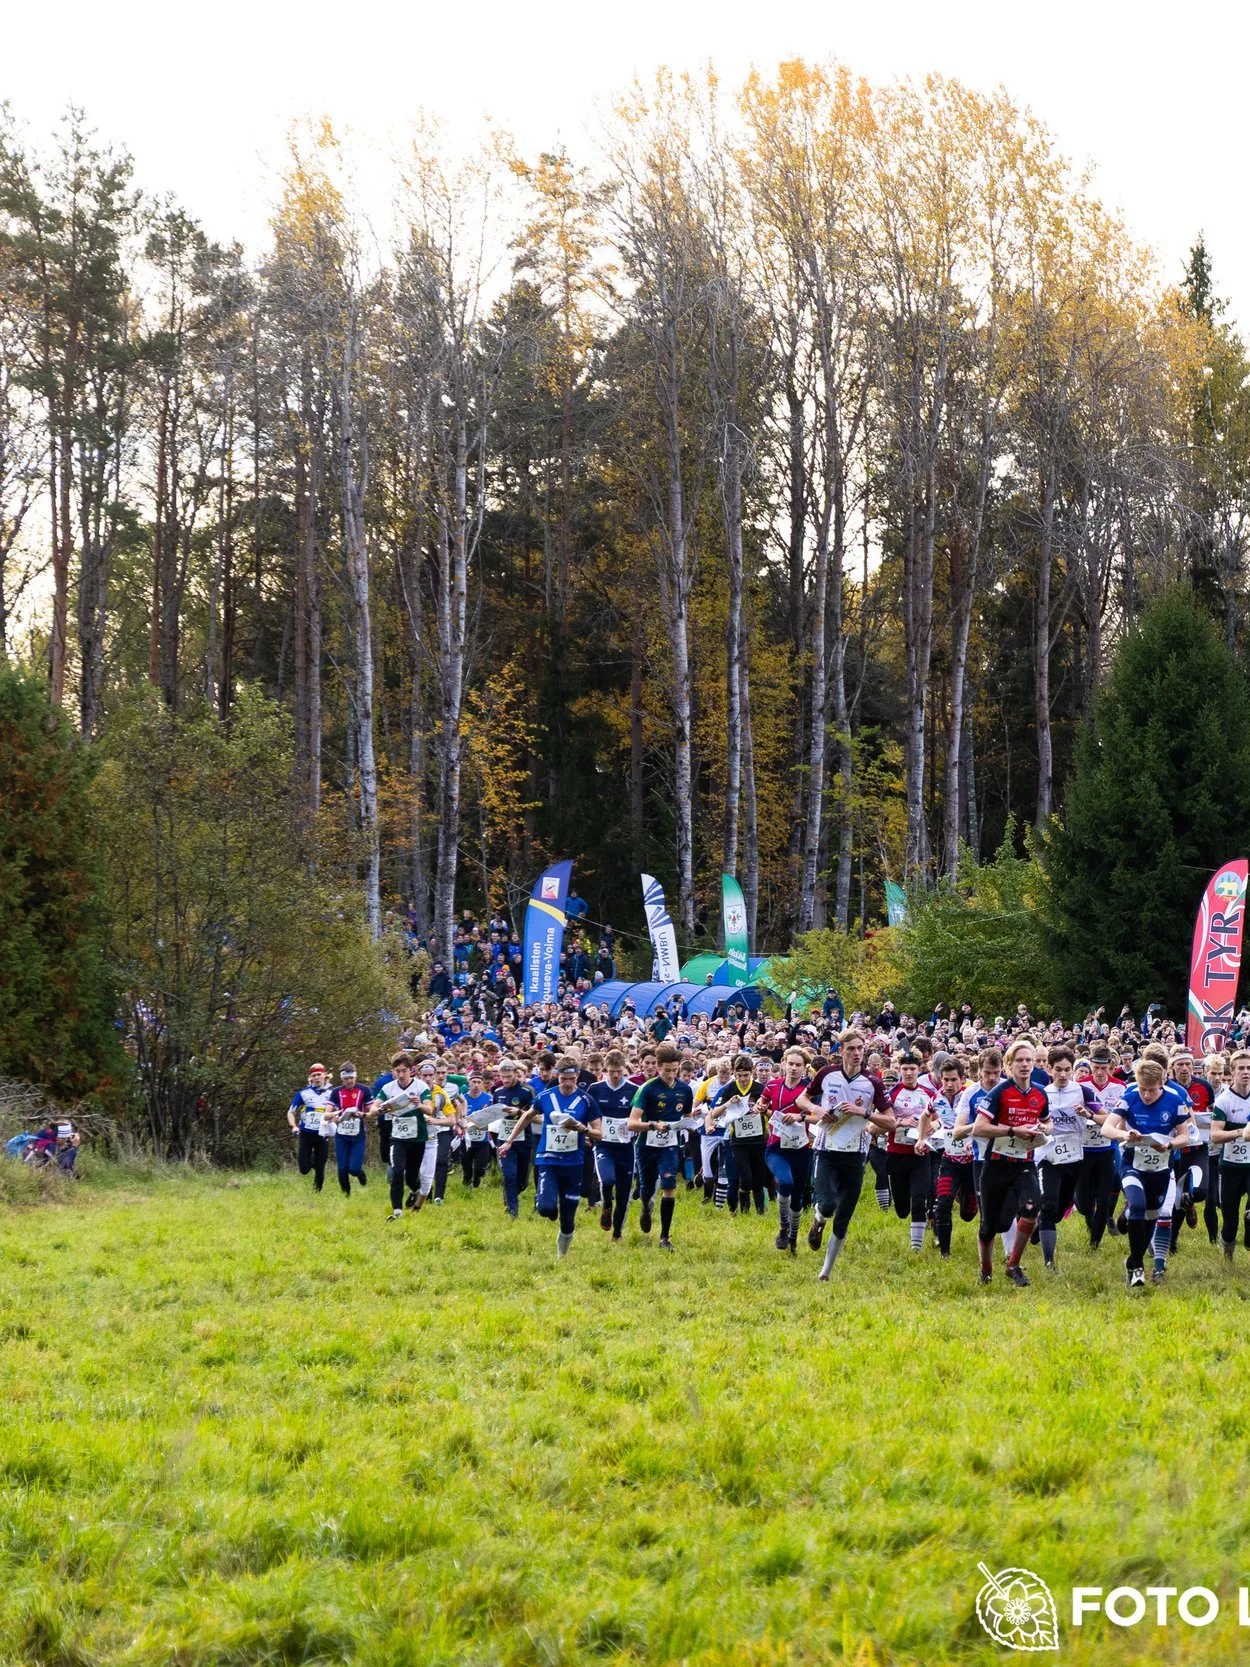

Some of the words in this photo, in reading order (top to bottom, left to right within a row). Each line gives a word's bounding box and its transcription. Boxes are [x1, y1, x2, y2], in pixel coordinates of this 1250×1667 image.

[1203, 911, 1241, 988] TYR
[529, 942, 541, 993] Ikaalisten
[342, 1122, 355, 1130] 103
[742, 1121, 754, 1130] 86
[554, 1134, 567, 1144] 47
[656, 1130, 669, 1139] 82
[1090, 1130, 1103, 1140] 24
[951, 1139, 964, 1148] 43
[1008, 1138, 1016, 1148] 1
[1055, 1143, 1069, 1155] 61
[1232, 1145, 1247, 1155] 26
[1144, 1154, 1160, 1165] 25
